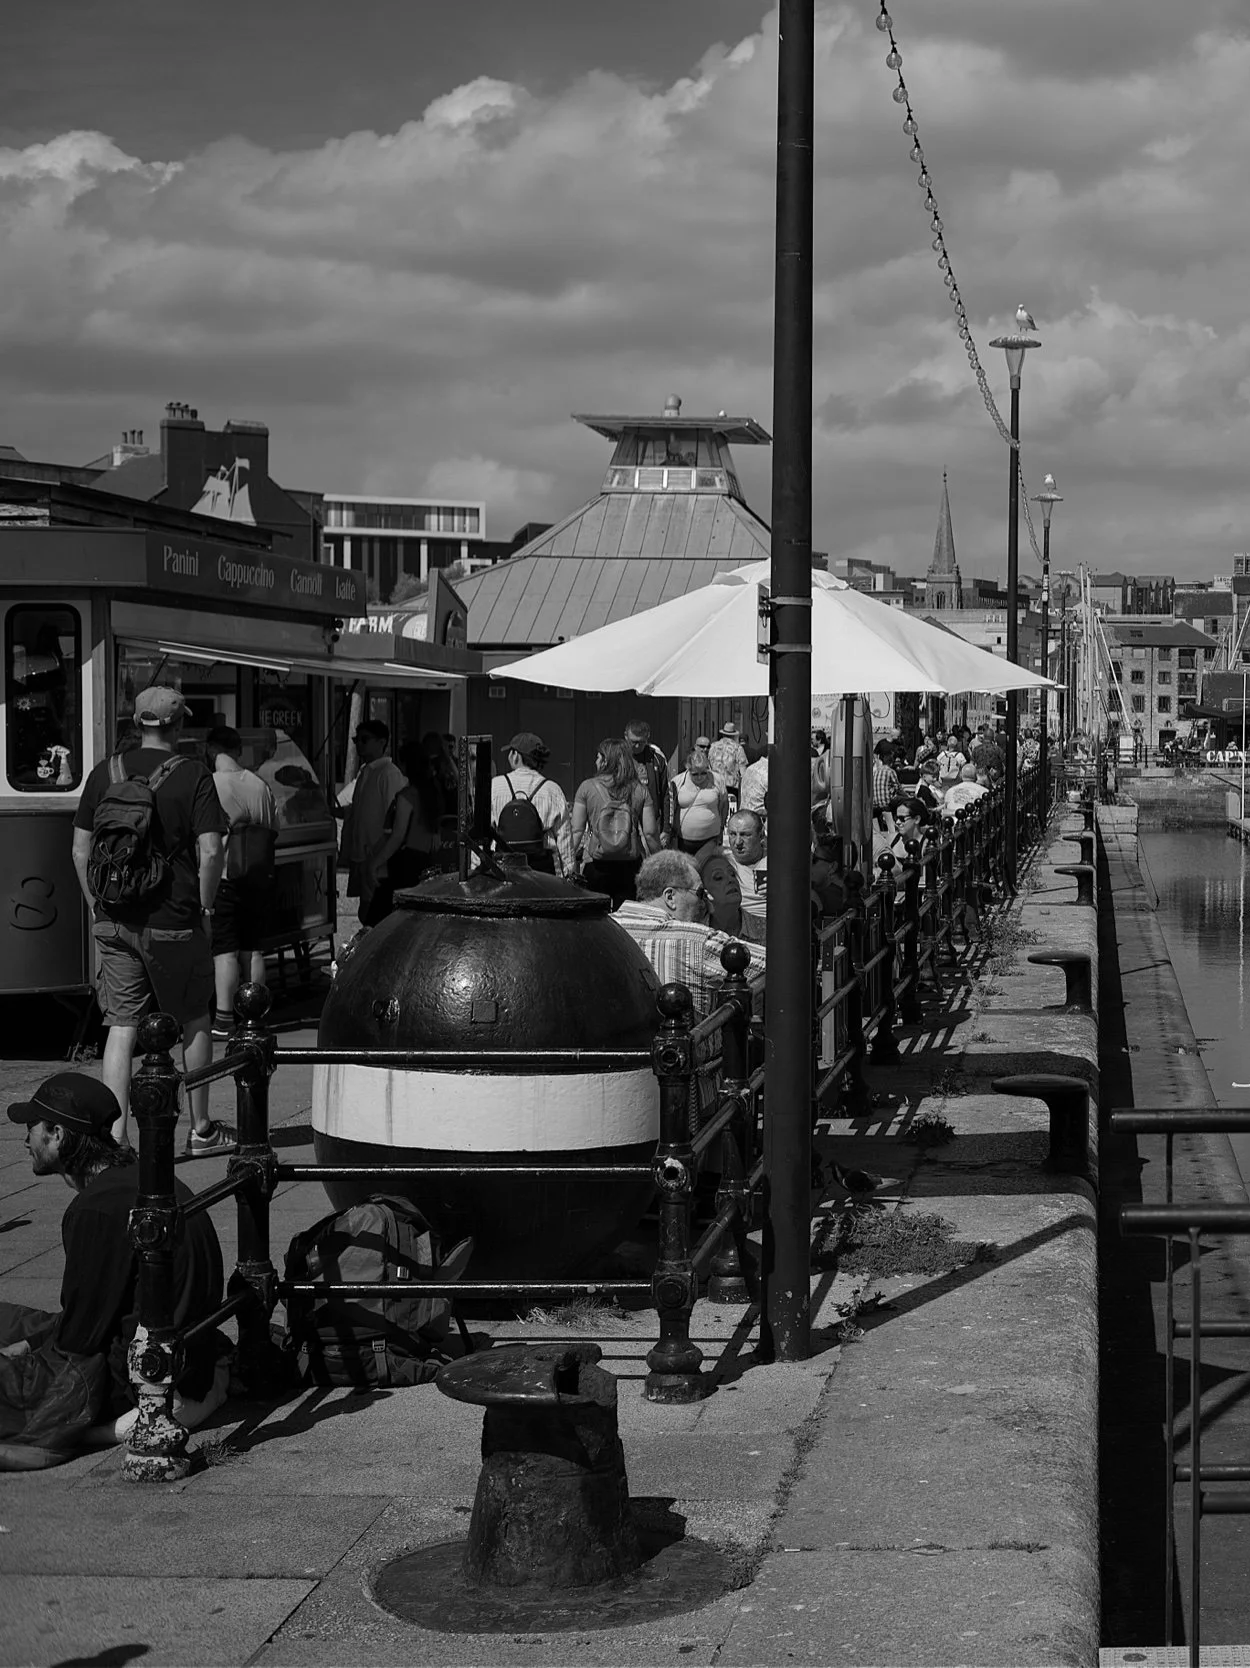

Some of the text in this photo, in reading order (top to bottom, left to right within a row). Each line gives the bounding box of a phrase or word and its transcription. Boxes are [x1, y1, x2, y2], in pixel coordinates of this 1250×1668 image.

[163, 545, 356, 601] Panini Cappuccino Cannoli Latte
[273, 709, 303, 727] GREEK
[1206, 750, 1247, 763] CAP'N
